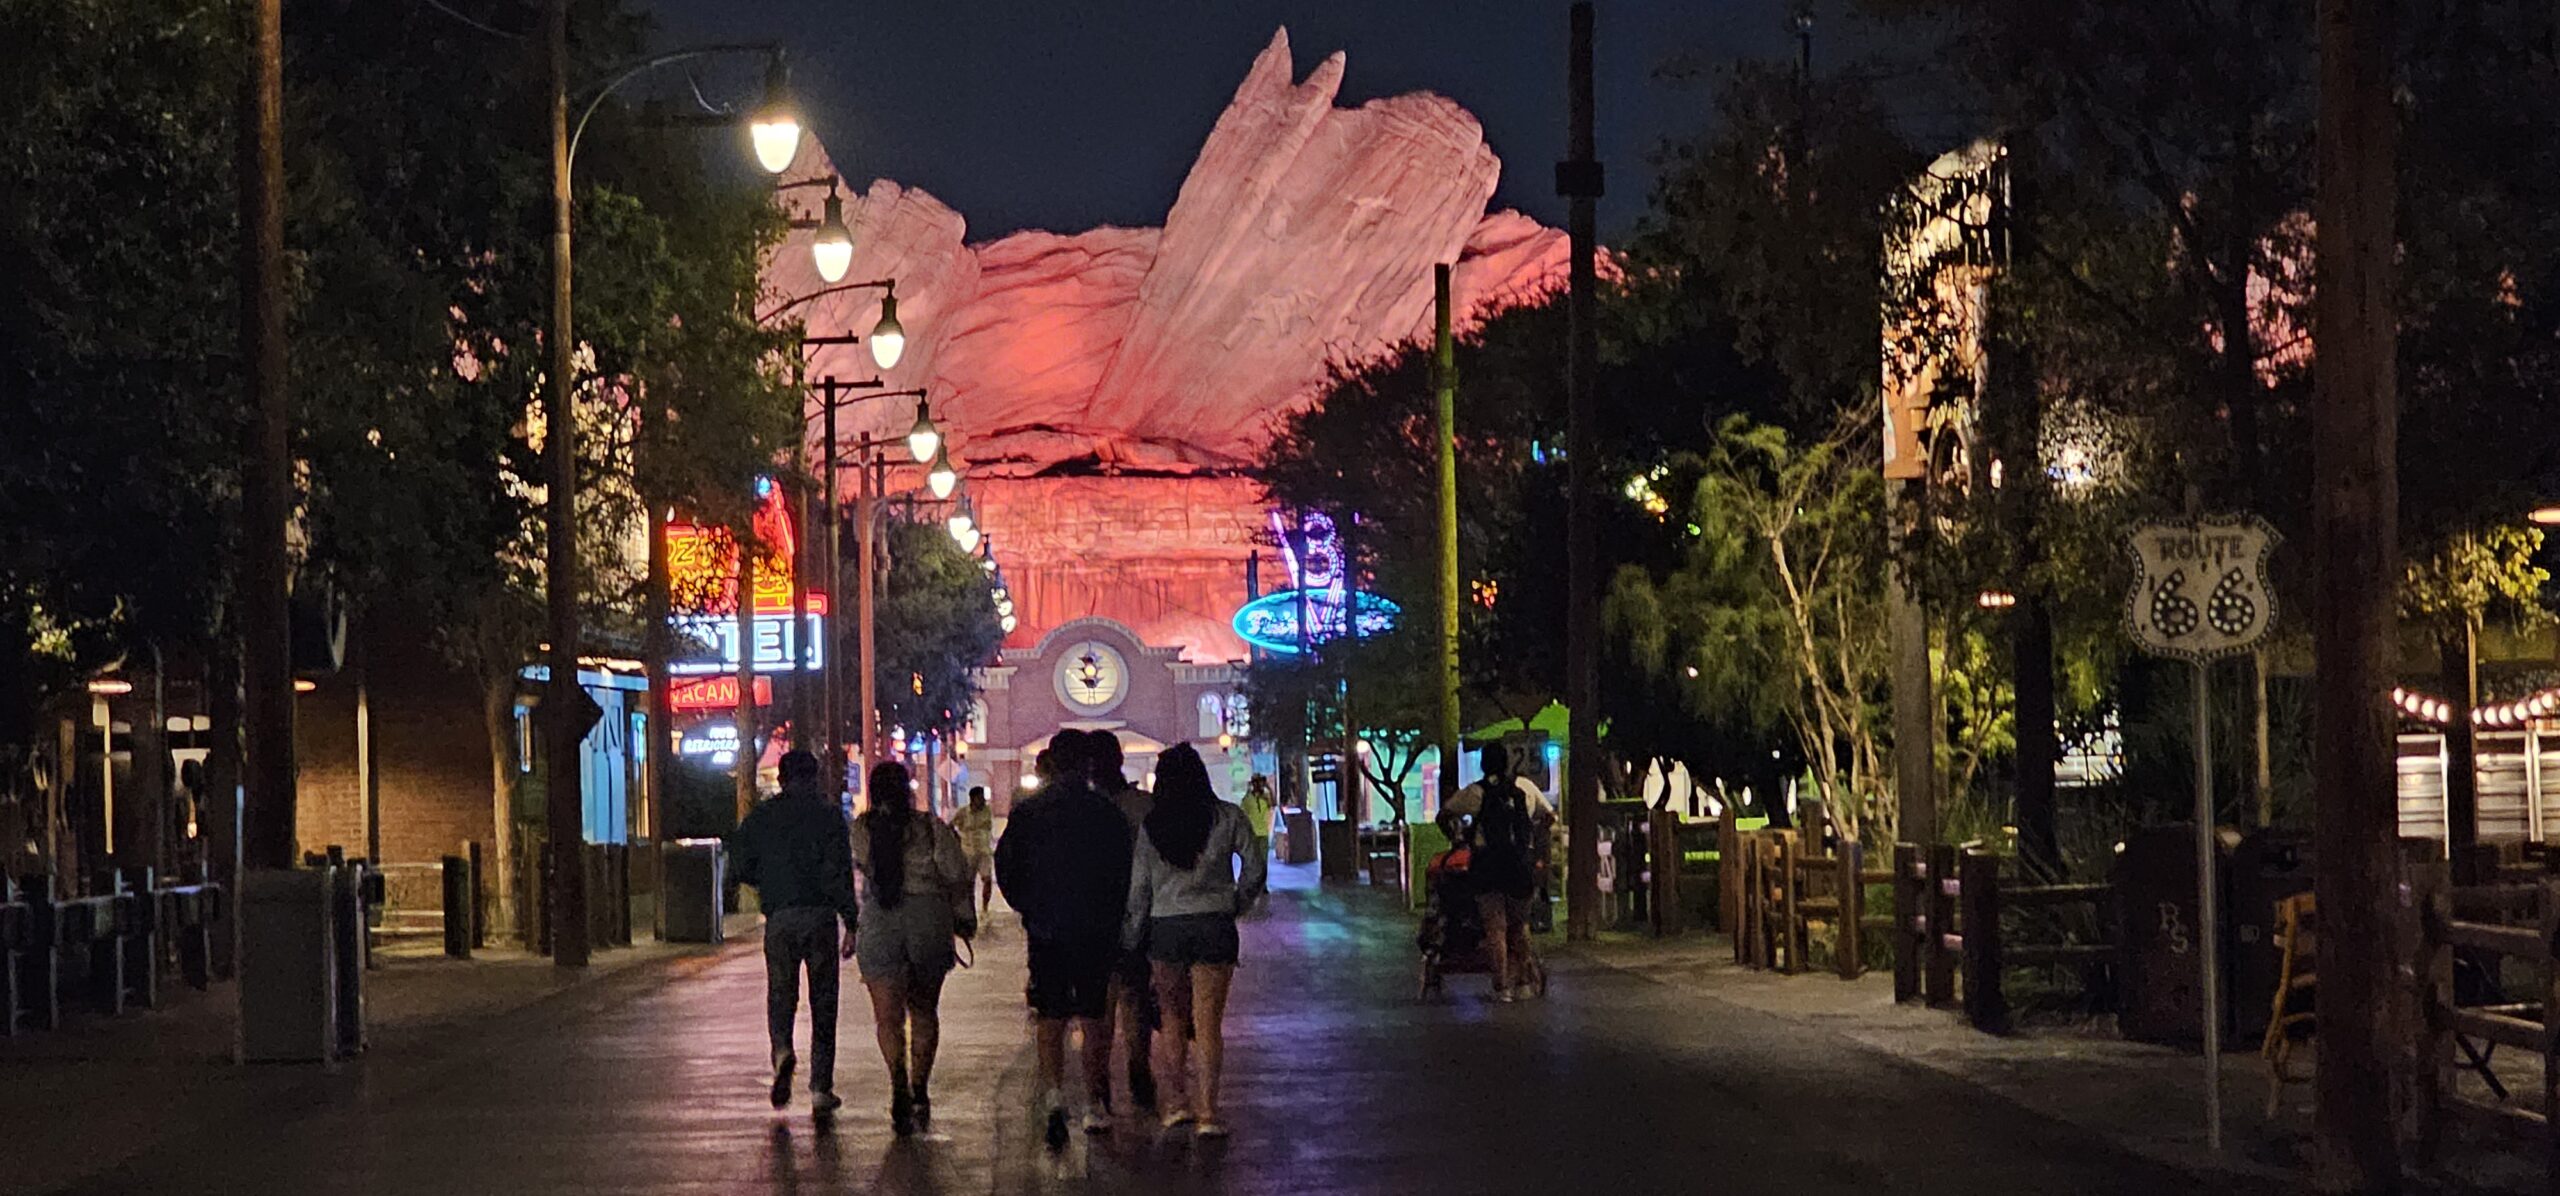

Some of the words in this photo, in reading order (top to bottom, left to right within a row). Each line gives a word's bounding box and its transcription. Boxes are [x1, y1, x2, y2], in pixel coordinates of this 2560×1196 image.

[2157, 535, 2244, 561] ROUTE
[2152, 567, 2255, 638] 66
[671, 683, 734, 704] VACAN
